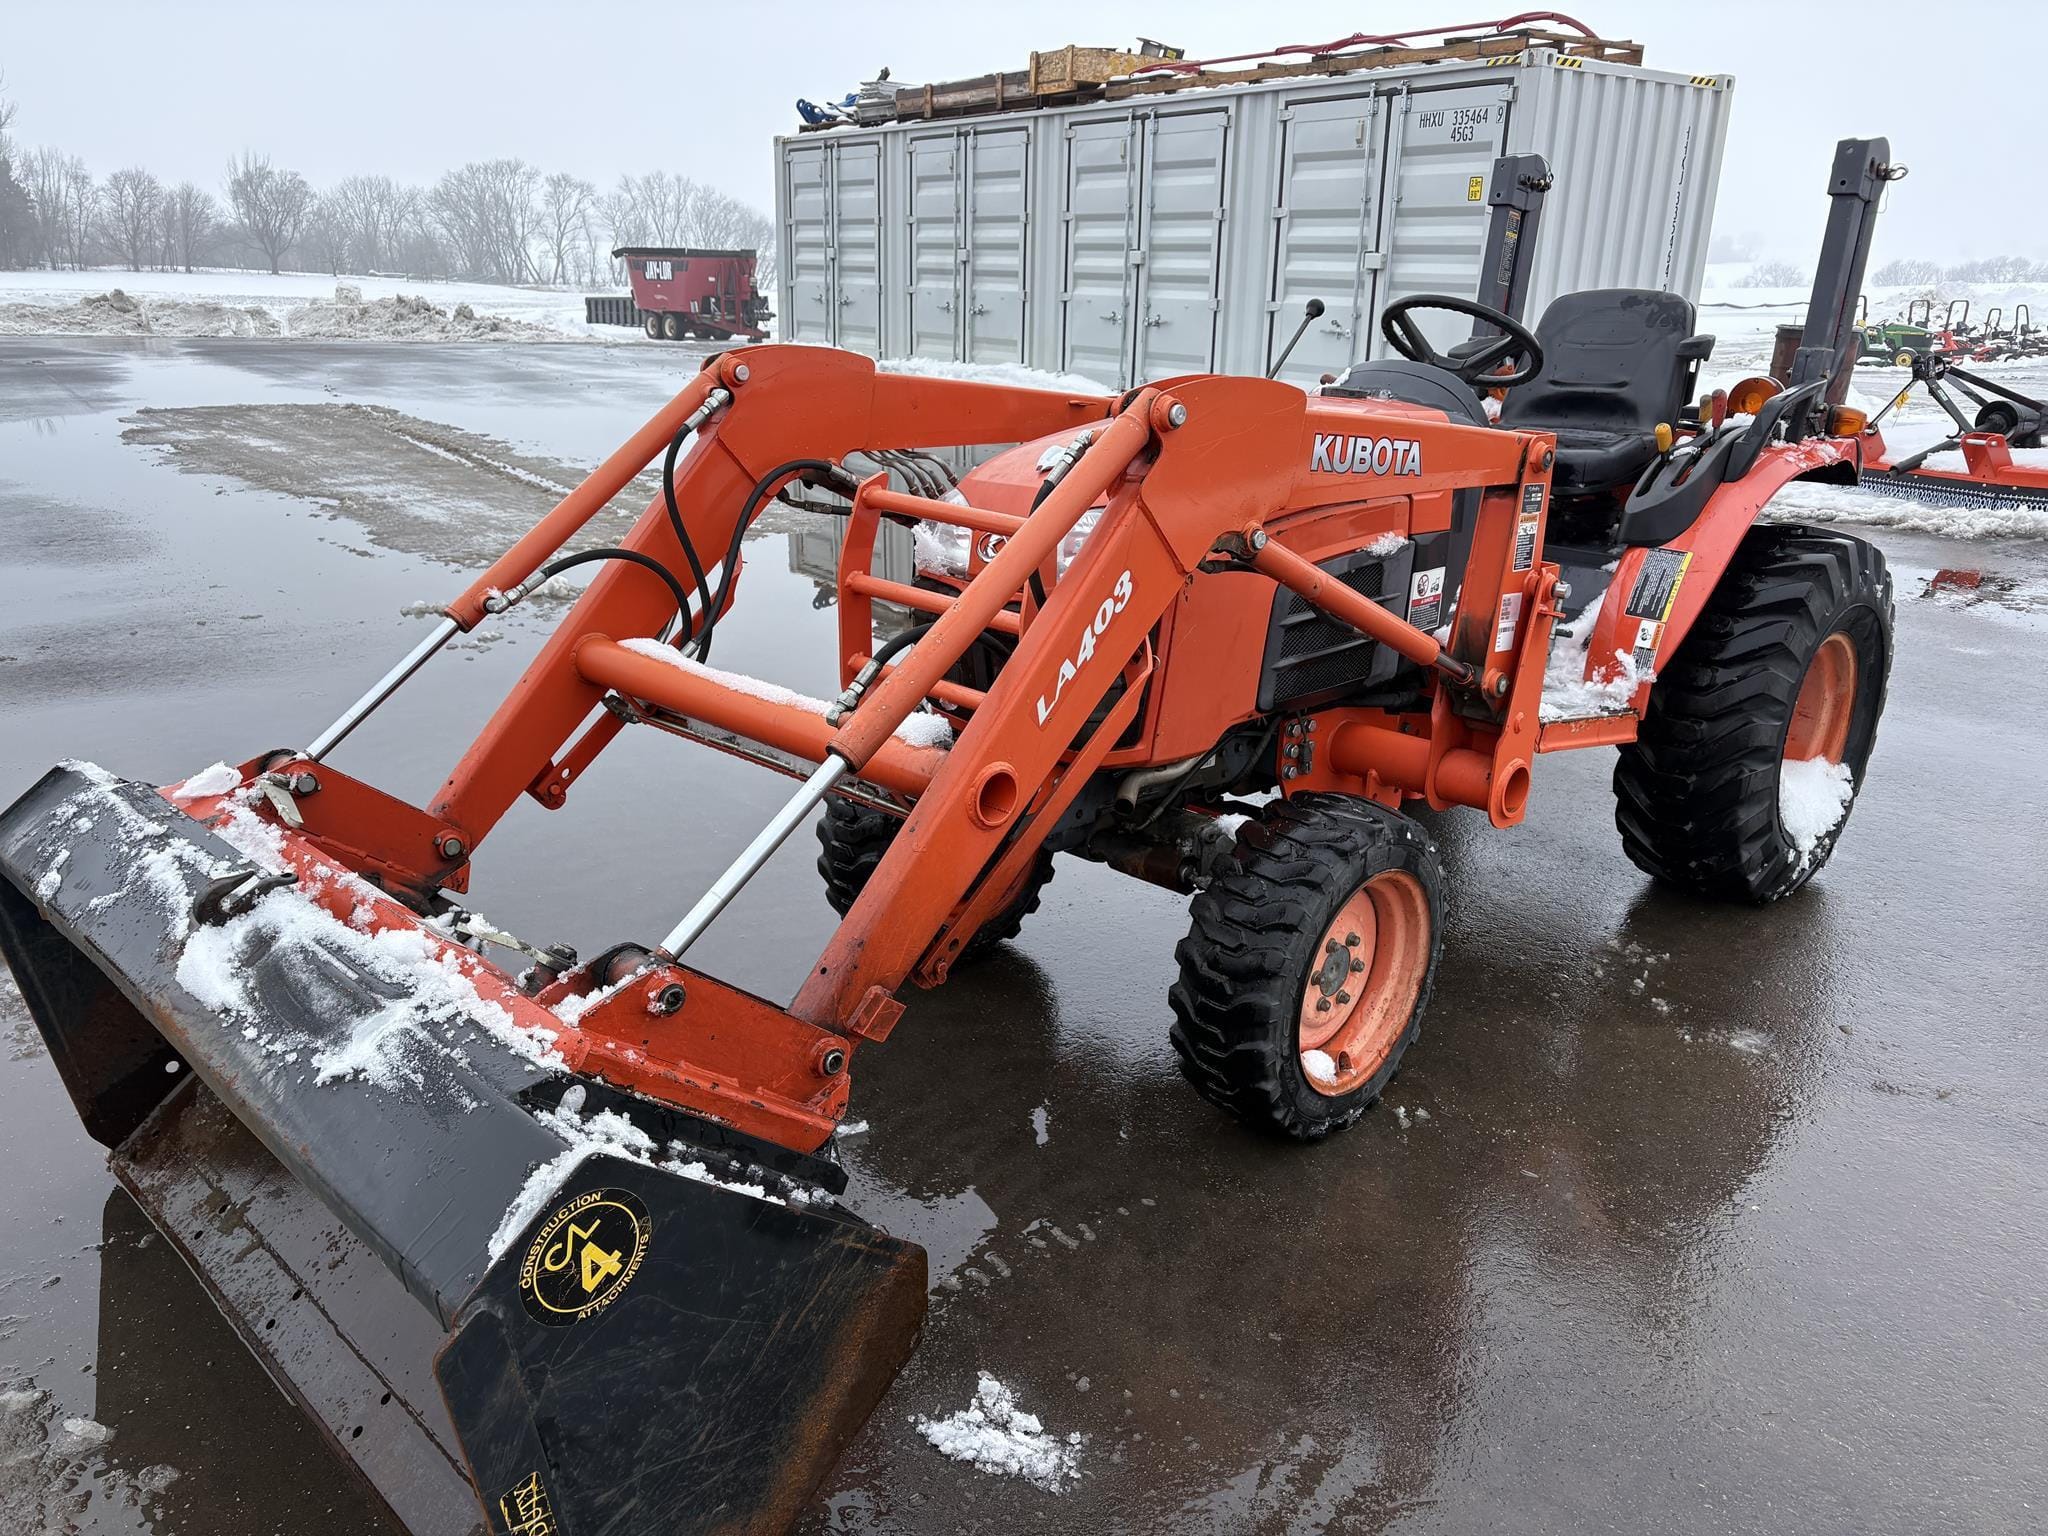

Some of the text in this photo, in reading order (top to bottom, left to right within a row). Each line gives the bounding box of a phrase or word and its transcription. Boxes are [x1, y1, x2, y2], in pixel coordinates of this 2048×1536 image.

[1419, 106, 1504, 128] HHXU 335464 9
[1450, 126, 1474, 142] 45G3
[1310, 432, 1422, 476] KUBOTA
[1036, 569, 1134, 727] LA403
[521, 1191, 602, 1289] CONSTRUCTION
[577, 1233, 650, 1319] ATTACHMENTS
[580, 1241, 623, 1294] 4
